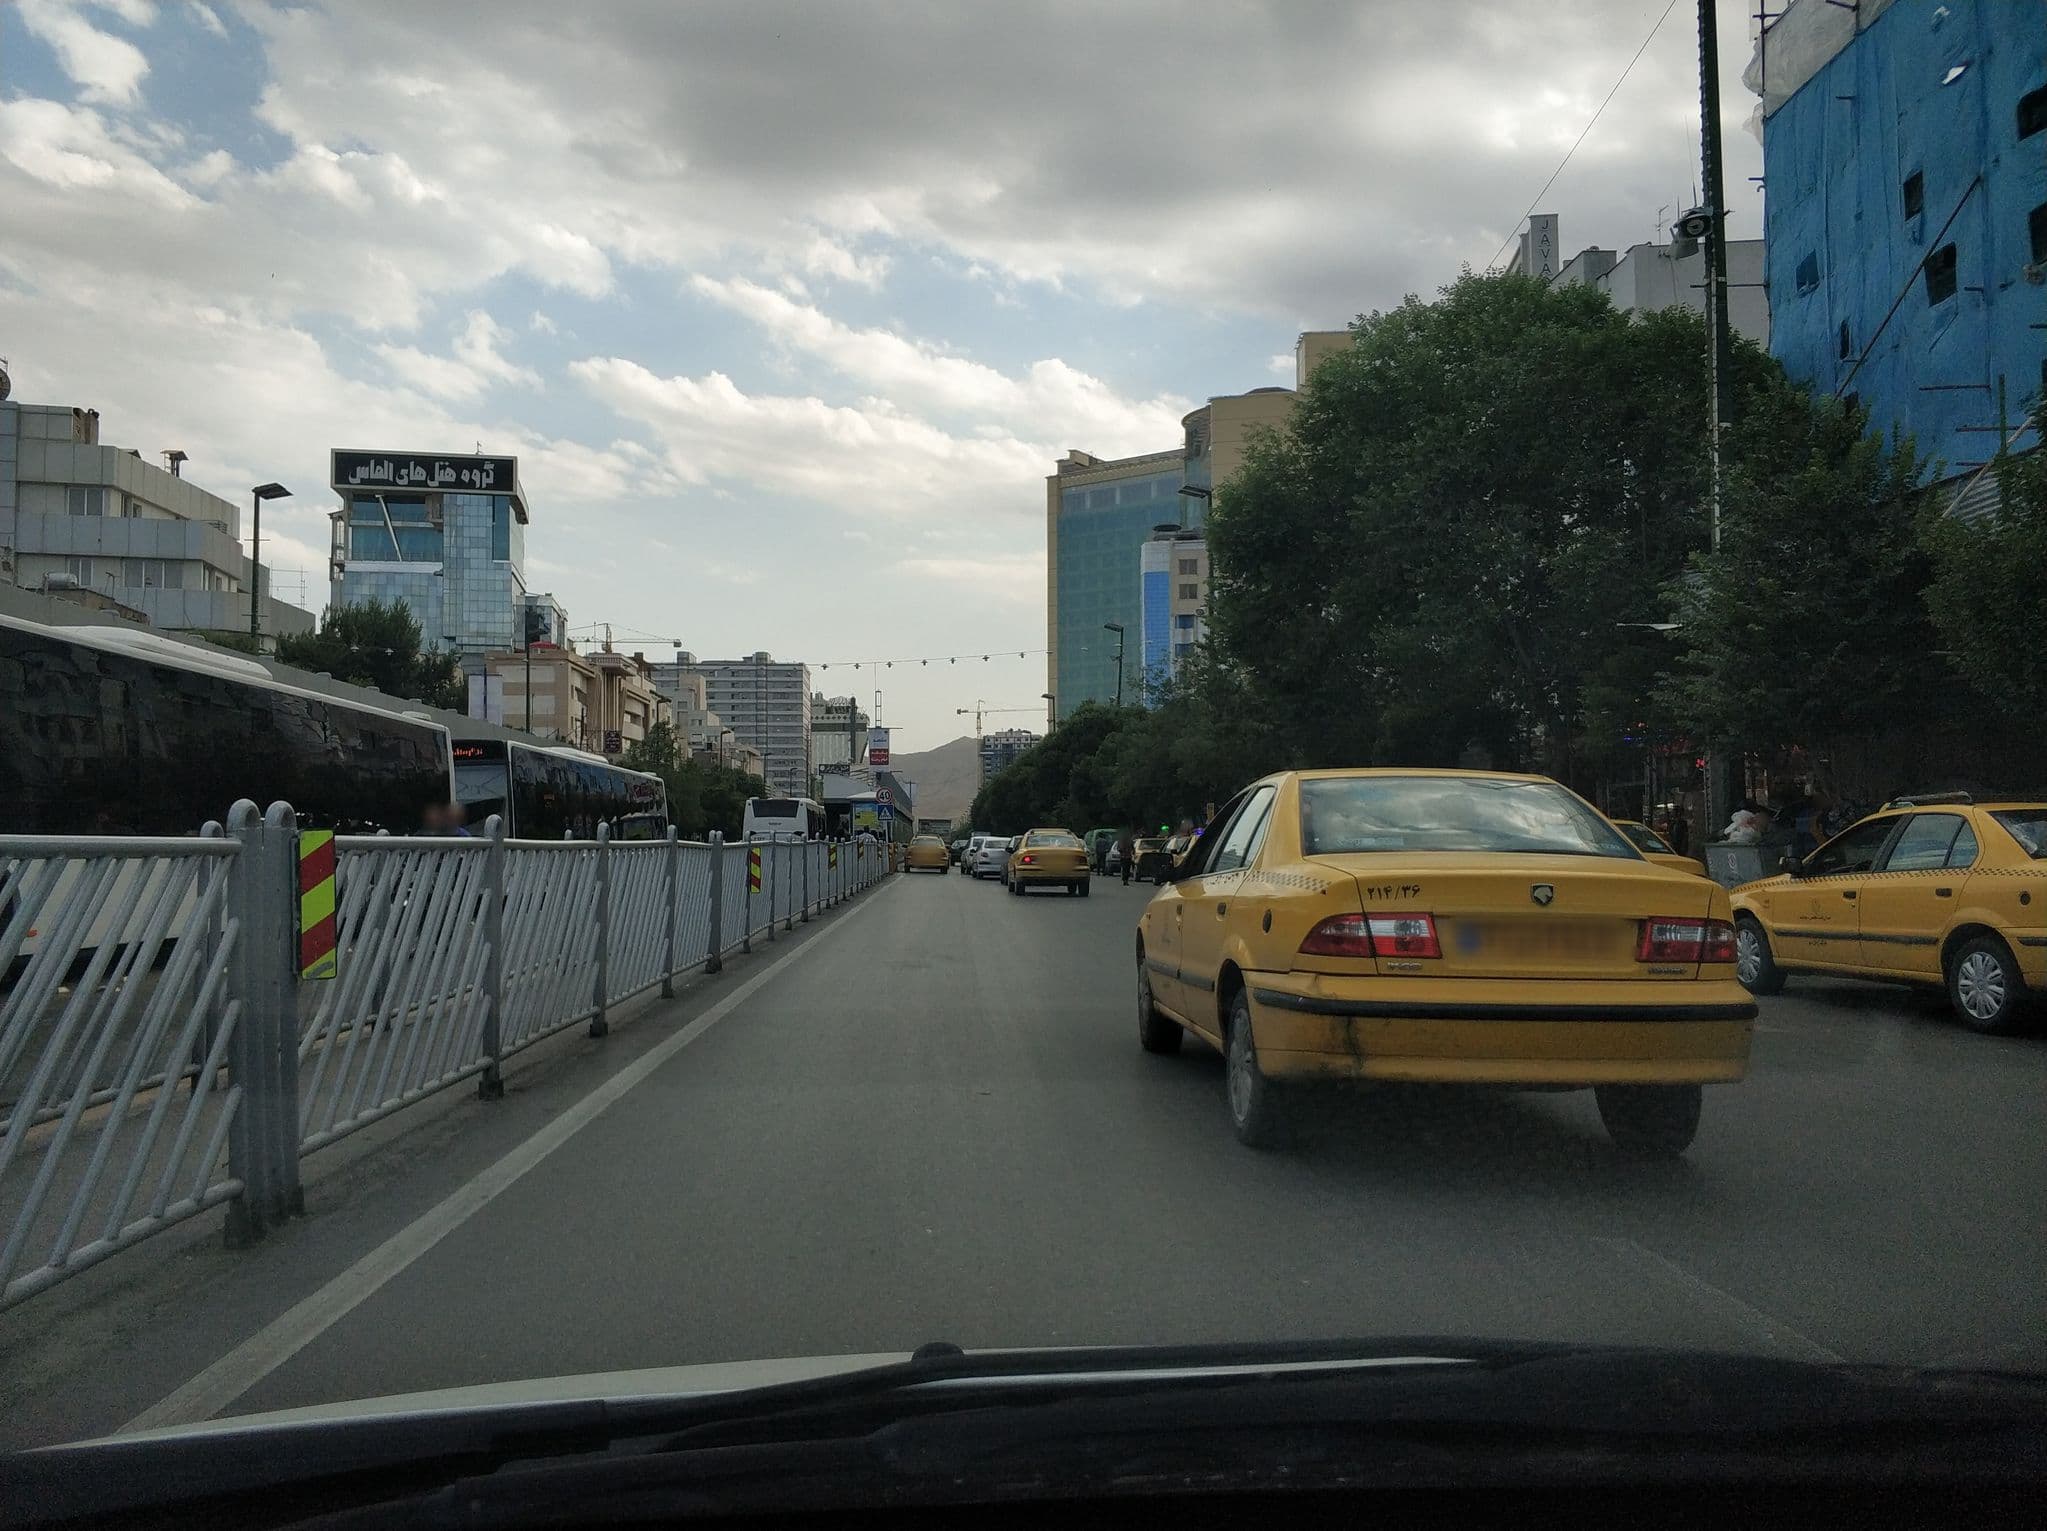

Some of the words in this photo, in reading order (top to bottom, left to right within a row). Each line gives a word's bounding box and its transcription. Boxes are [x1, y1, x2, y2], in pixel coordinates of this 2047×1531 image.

[348, 459, 394, 484] الماس
[396, 461, 427, 485] های
[427, 461, 457, 487] هتل
[461, 461, 495, 488] گروه
[880, 791, 891, 801] 40
